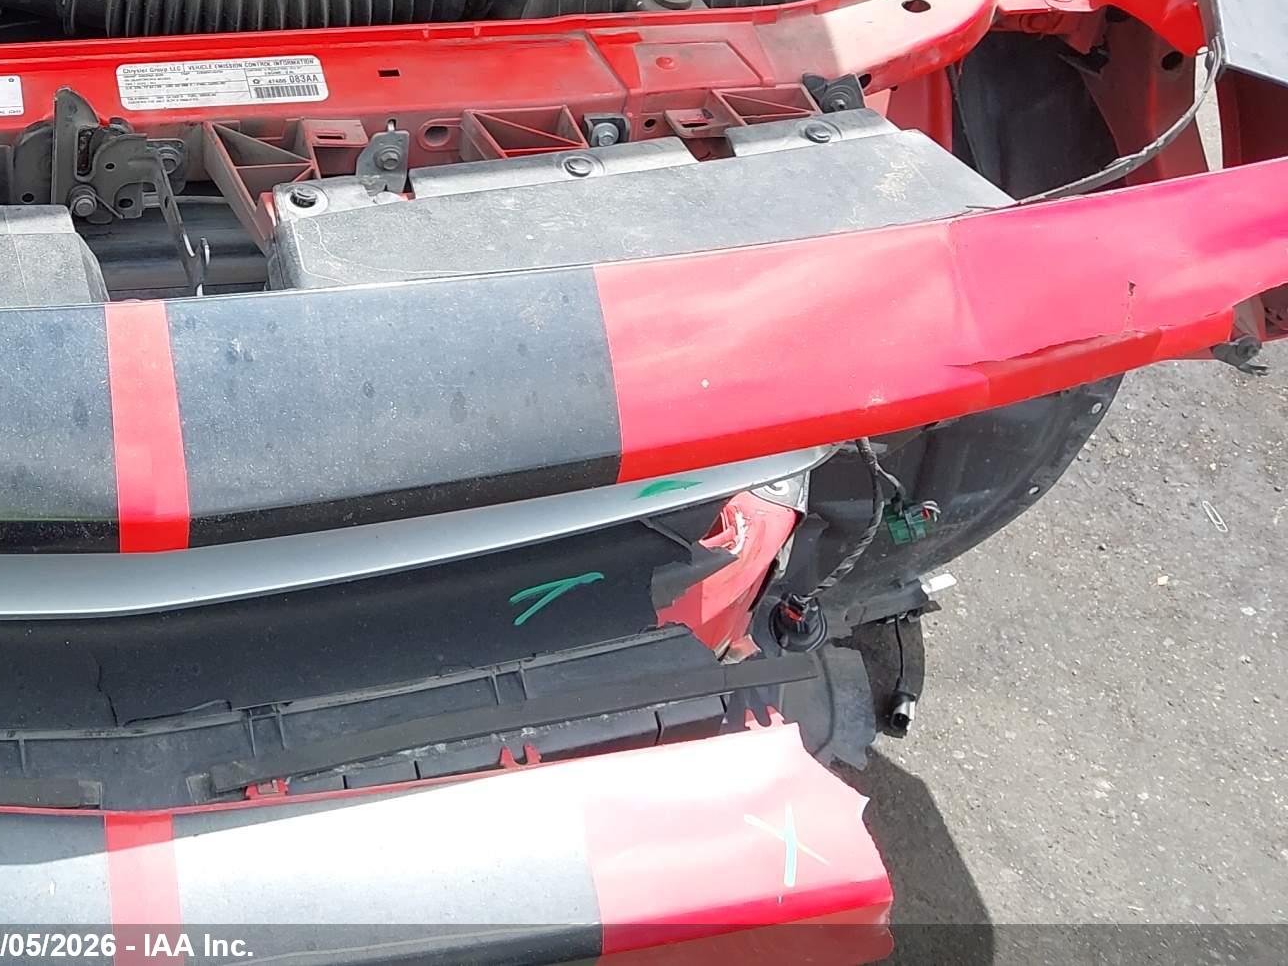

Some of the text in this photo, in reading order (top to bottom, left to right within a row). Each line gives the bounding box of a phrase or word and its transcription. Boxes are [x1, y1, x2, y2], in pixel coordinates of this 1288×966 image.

[273, 58, 314, 66] INFORMATION
[122, 67, 148, 75] Chrysler
[149, 66, 168, 74] Group
[288, 74, 318, 83] 083AA
